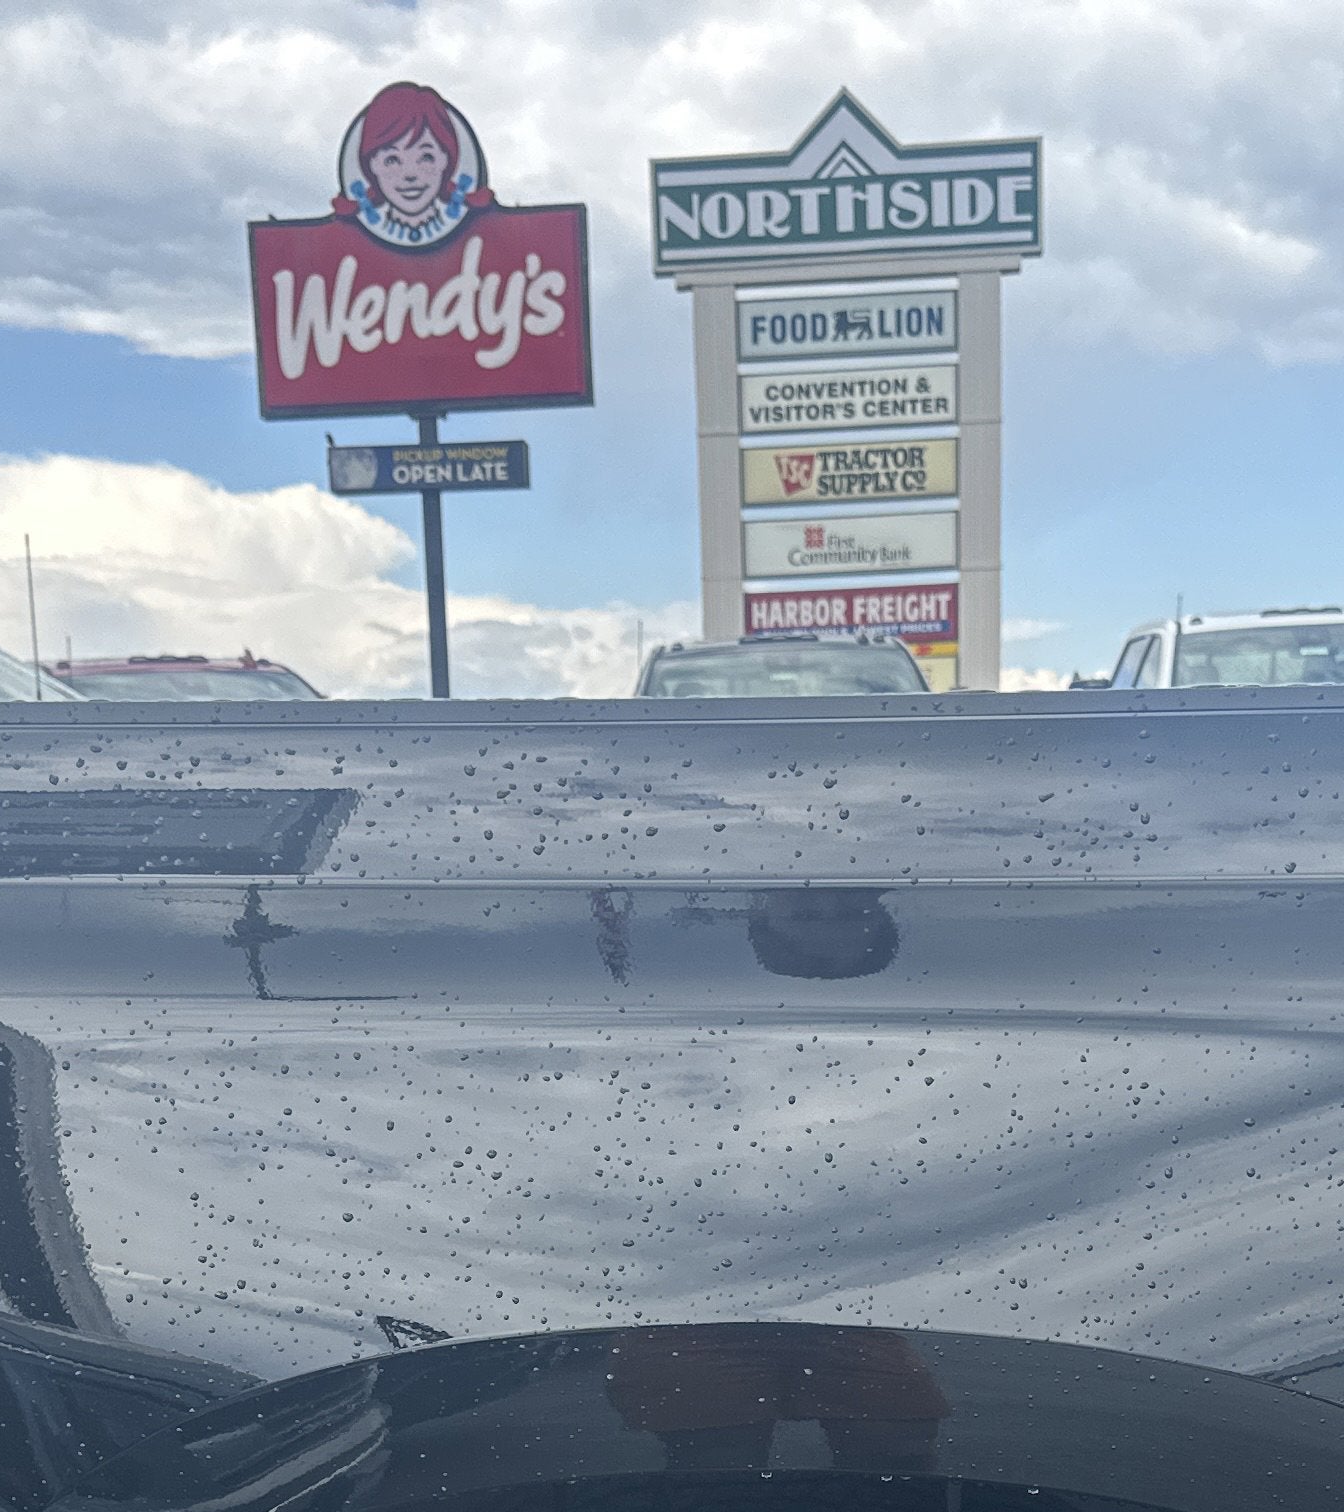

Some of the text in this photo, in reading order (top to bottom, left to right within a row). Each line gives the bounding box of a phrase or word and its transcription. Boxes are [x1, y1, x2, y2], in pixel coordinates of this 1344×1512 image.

[659, 175, 1034, 242] NORTHSIDE
[272, 236, 566, 380] Wendy's
[751, 305, 946, 345] FOOD LION
[765, 376, 931, 402] CONVENTION &
[749, 396, 949, 424] VISITOR'S CENTER
[447, 446, 509, 461] WINDOW
[816, 447, 926, 472] TRACTOR
[392, 460, 509, 485] OPEN LATE
[817, 471, 898, 496] SUPPLY
[787, 544, 913, 567] Community Bank
[750, 591, 953, 629] HARBOR FREIGHT
